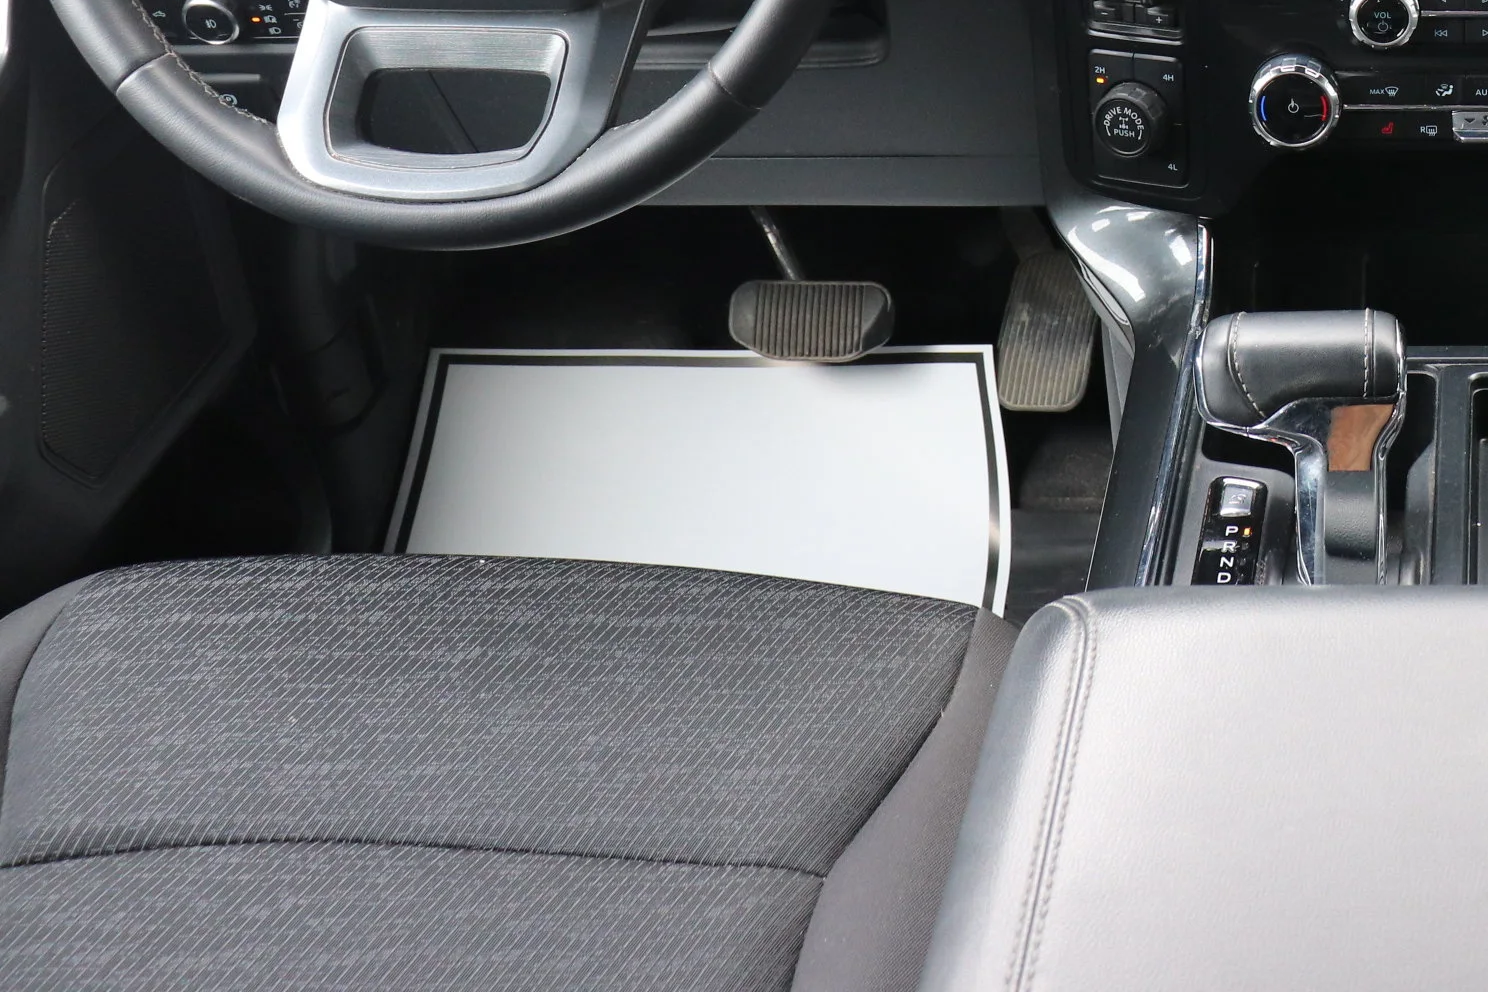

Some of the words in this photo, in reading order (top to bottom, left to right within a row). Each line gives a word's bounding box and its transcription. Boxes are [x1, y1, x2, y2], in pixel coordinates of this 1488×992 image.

[1374, 12, 1392, 20] VOL
[1094, 66, 1106, 74] 2H
[1162, 74, 1174, 82] 4H
[1370, 88, 1385, 96] MAX
[1104, 106, 1122, 127] DRIVE
[1123, 106, 1145, 130] MODE
[1113, 128, 1135, 138] PUSH
[1420, 126, 1426, 134] R
[1167, 163, 1178, 172] 4L
[1225, 526, 1238, 536] P
[1221, 541, 1236, 553] R
[1220, 556, 1234, 568] N
[1216, 572, 1232, 584] D
